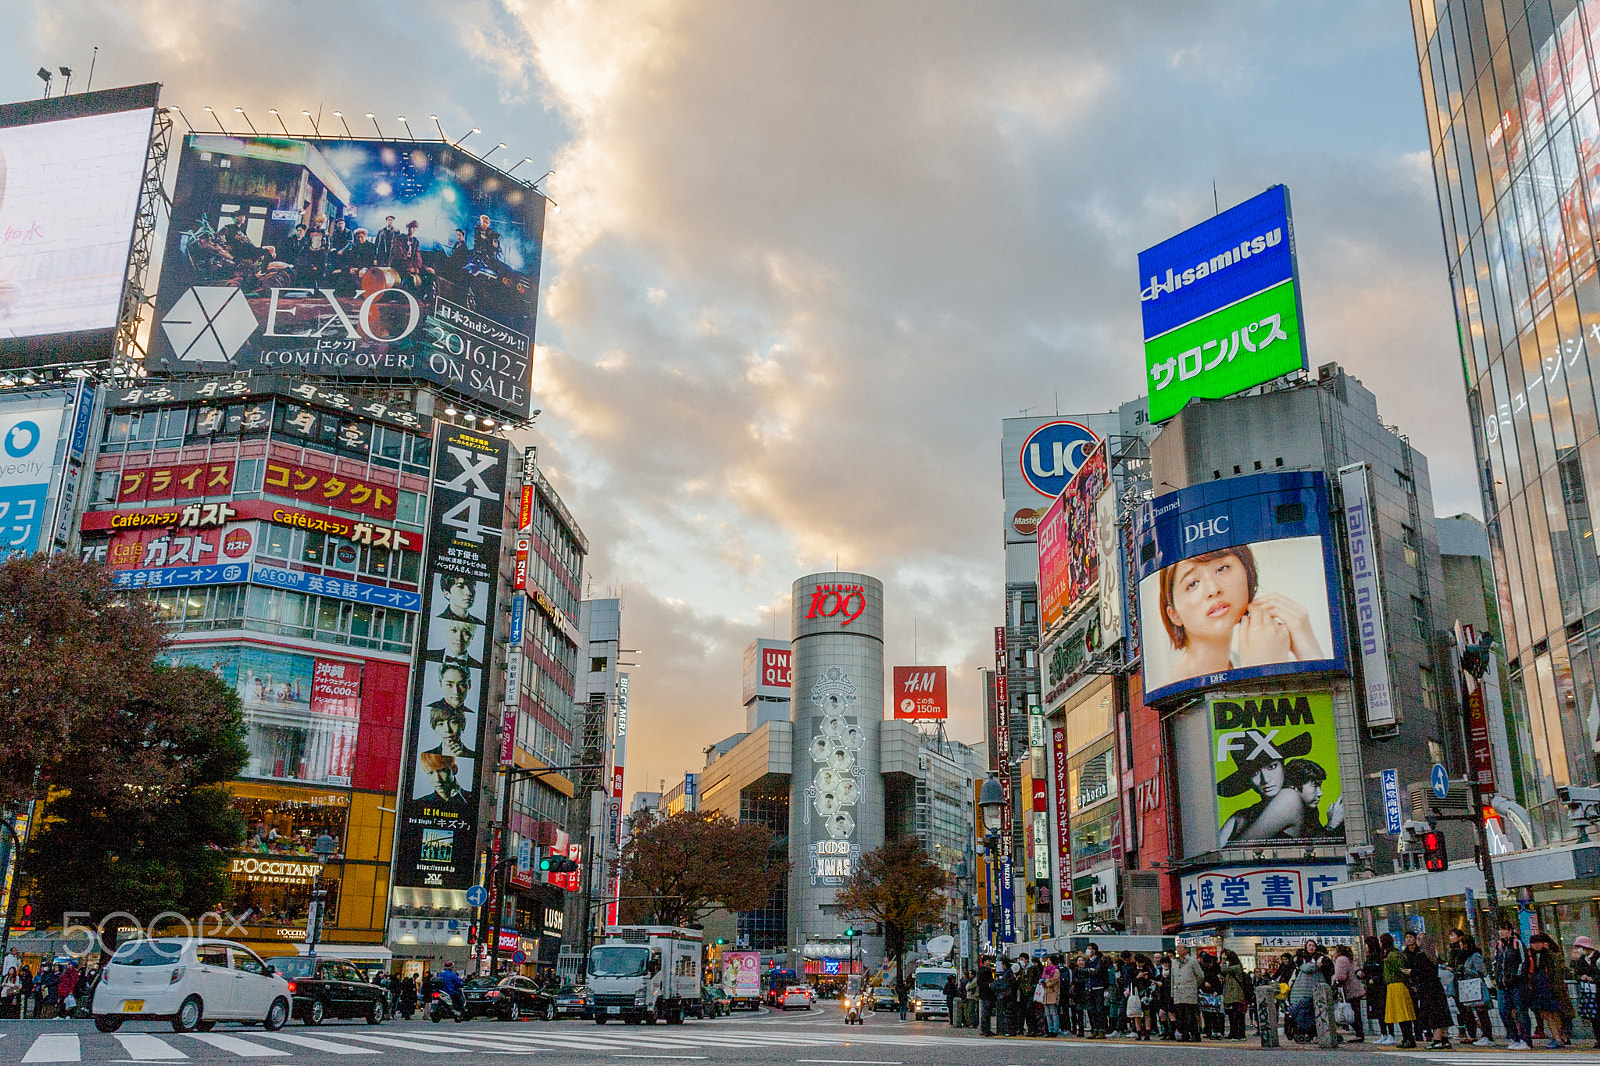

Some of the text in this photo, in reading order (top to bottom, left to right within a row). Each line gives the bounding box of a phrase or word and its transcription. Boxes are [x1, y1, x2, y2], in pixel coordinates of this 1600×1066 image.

[1140, 227, 1282, 301] Hisamitsu
[263, 287, 420, 342] EXO
[441, 304, 525, 351] 日本2ndシングル!!
[432, 326, 527, 382] 2016.12.7
[1151, 313, 1287, 391] サロンパス
[430, 353, 524, 406] ON SALE
[123, 465, 230, 495] プライス
[266, 464, 393, 509] コンタクト
[180, 502, 237, 528] ガスト
[1151, 500, 1181, 520] Channel
[351, 523, 410, 550] ガスト
[1040, 508, 1064, 557] GOT7
[1184, 515, 1230, 544] DHC
[144, 535, 214, 567] ガスト
[118, 568, 218, 587] 英会話イーオン
[260, 569, 298, 585] AEON
[516, 558, 527, 585] ガスト
[1347, 497, 1377, 656] Taisei neon
[308, 576, 418, 607] 英会話イーオン
[816, 584, 864, 593] SHIBUYA
[805, 591, 866, 625] 109
[619, 677, 629, 693] BIC
[904, 672, 936, 693] H&M
[1210, 672, 1228, 683] DHC
[1369, 683, 1385, 693] (03)
[917, 704, 941, 714] 150m
[1213, 697, 1315, 730] DMM
[1217, 729, 1283, 762] FX
[1472, 728, 1493, 784] 三千里
[1056, 751, 1068, 846] ウィンターフルーツギフト
[817, 841, 850, 854] 109
[263, 876, 306, 884] PROVENCE
[817, 859, 850, 876] XMAS
[545, 908, 564, 931] LUSH
